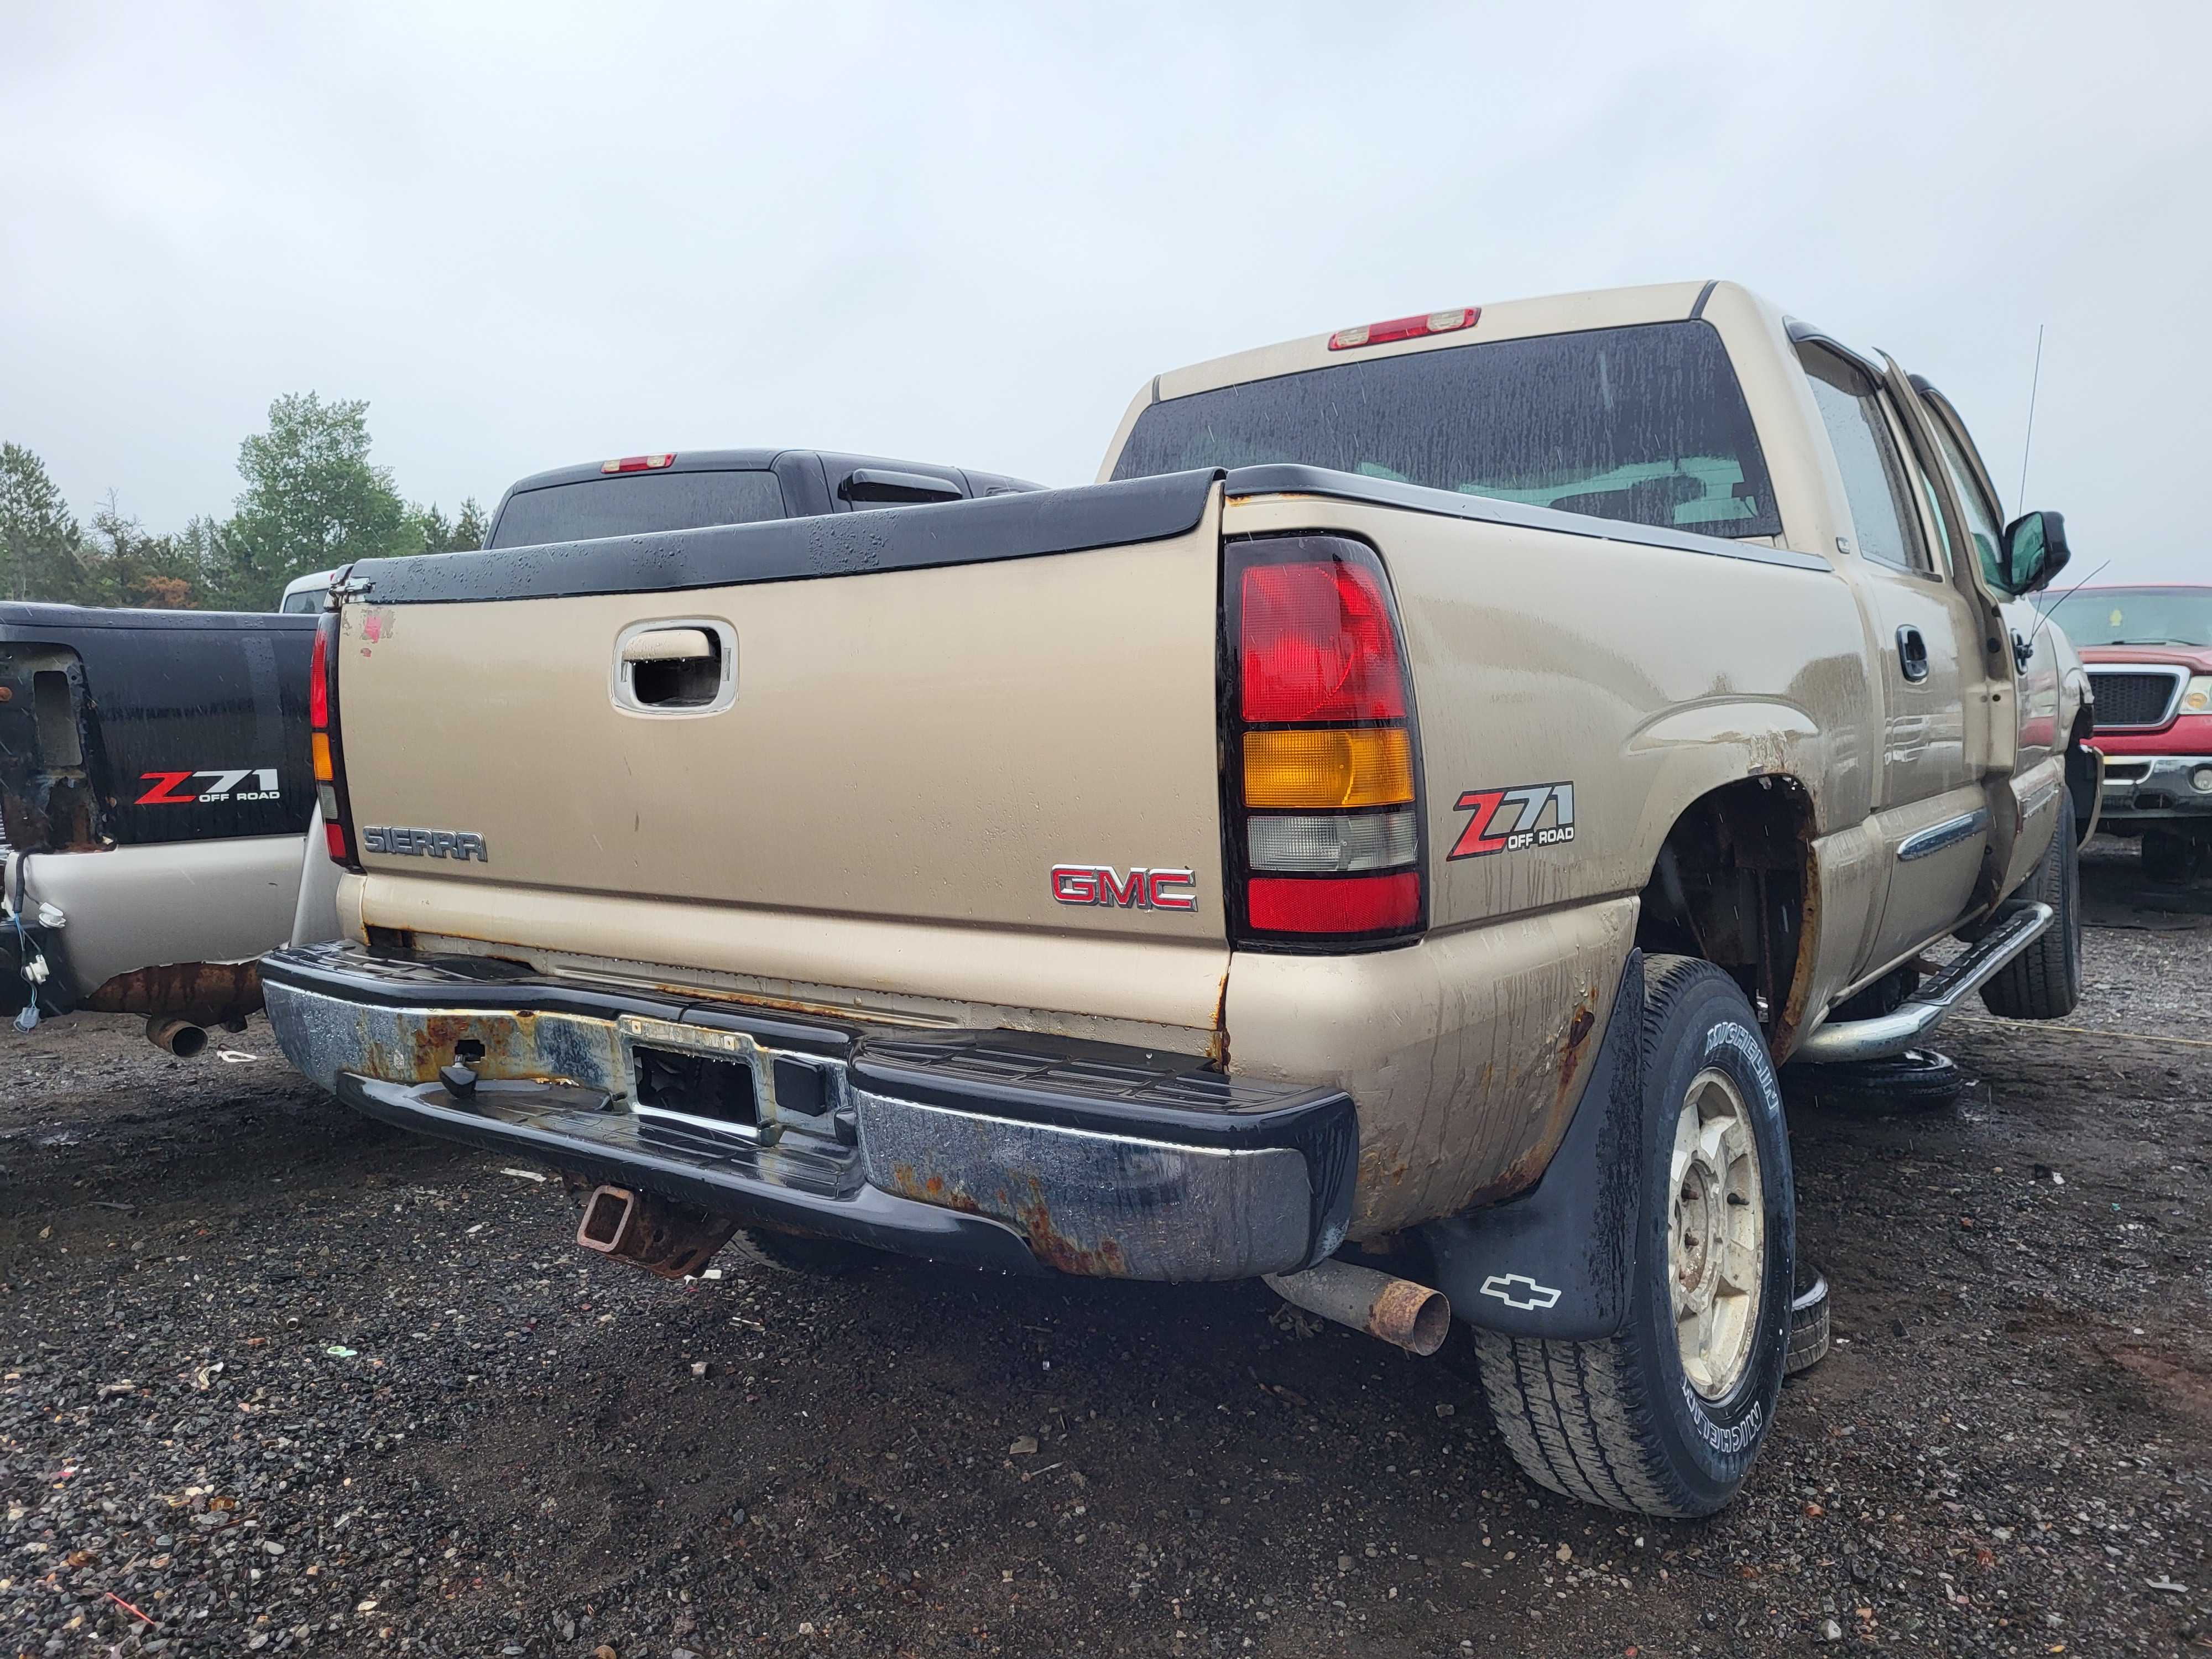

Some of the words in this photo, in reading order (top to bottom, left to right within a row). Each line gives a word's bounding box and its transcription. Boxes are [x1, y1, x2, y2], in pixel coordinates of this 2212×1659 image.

[134, 769, 278, 804] Z71
[199, 794, 229, 802] OFF
[237, 791, 280, 801] ROAD
[1447, 781, 1574, 861] Z71
[1507, 833, 1533, 849] OFF
[1538, 827, 1574, 844] ROAD
[363, 826, 488, 863] SIERRA
[1051, 864, 1198, 912] GMC
[1704, 1021, 1779, 1110] MICHELIN
[1680, 1375, 1762, 1453] MICHELIN
